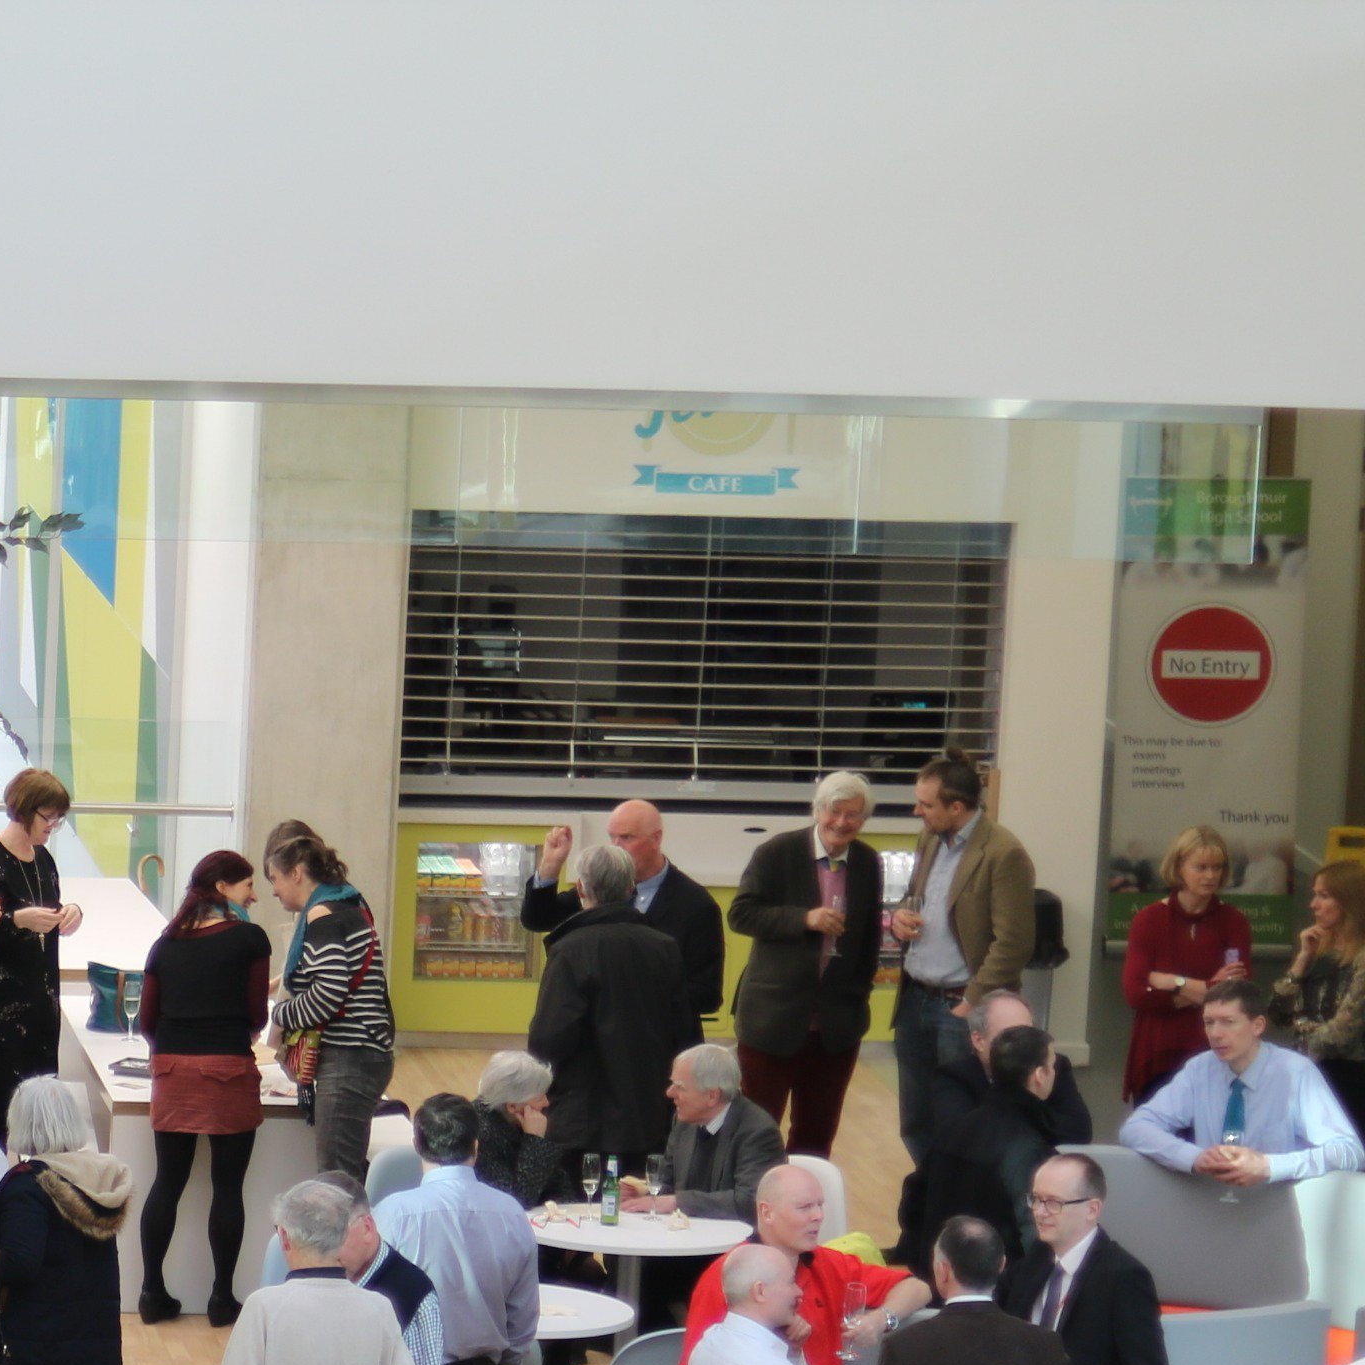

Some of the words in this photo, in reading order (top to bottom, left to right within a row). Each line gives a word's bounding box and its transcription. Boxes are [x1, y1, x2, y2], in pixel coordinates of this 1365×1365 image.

[688, 476, 742, 493] CAFE
[1200, 510, 1232, 526] High
[1170, 657, 1196, 674] No
[1201, 657, 1250, 679] Entry
[1122, 734, 1144, 746] This
[1146, 738, 1168, 748] may
[1170, 735, 1183, 747] be
[1186, 736, 1205, 747] due
[1133, 752, 1166, 760] exams
[1132, 765, 1181, 777] meetings
[1132, 779, 1185, 789] interviews
[1220, 810, 1260, 823] Thank
[1265, 813, 1289, 825] you
